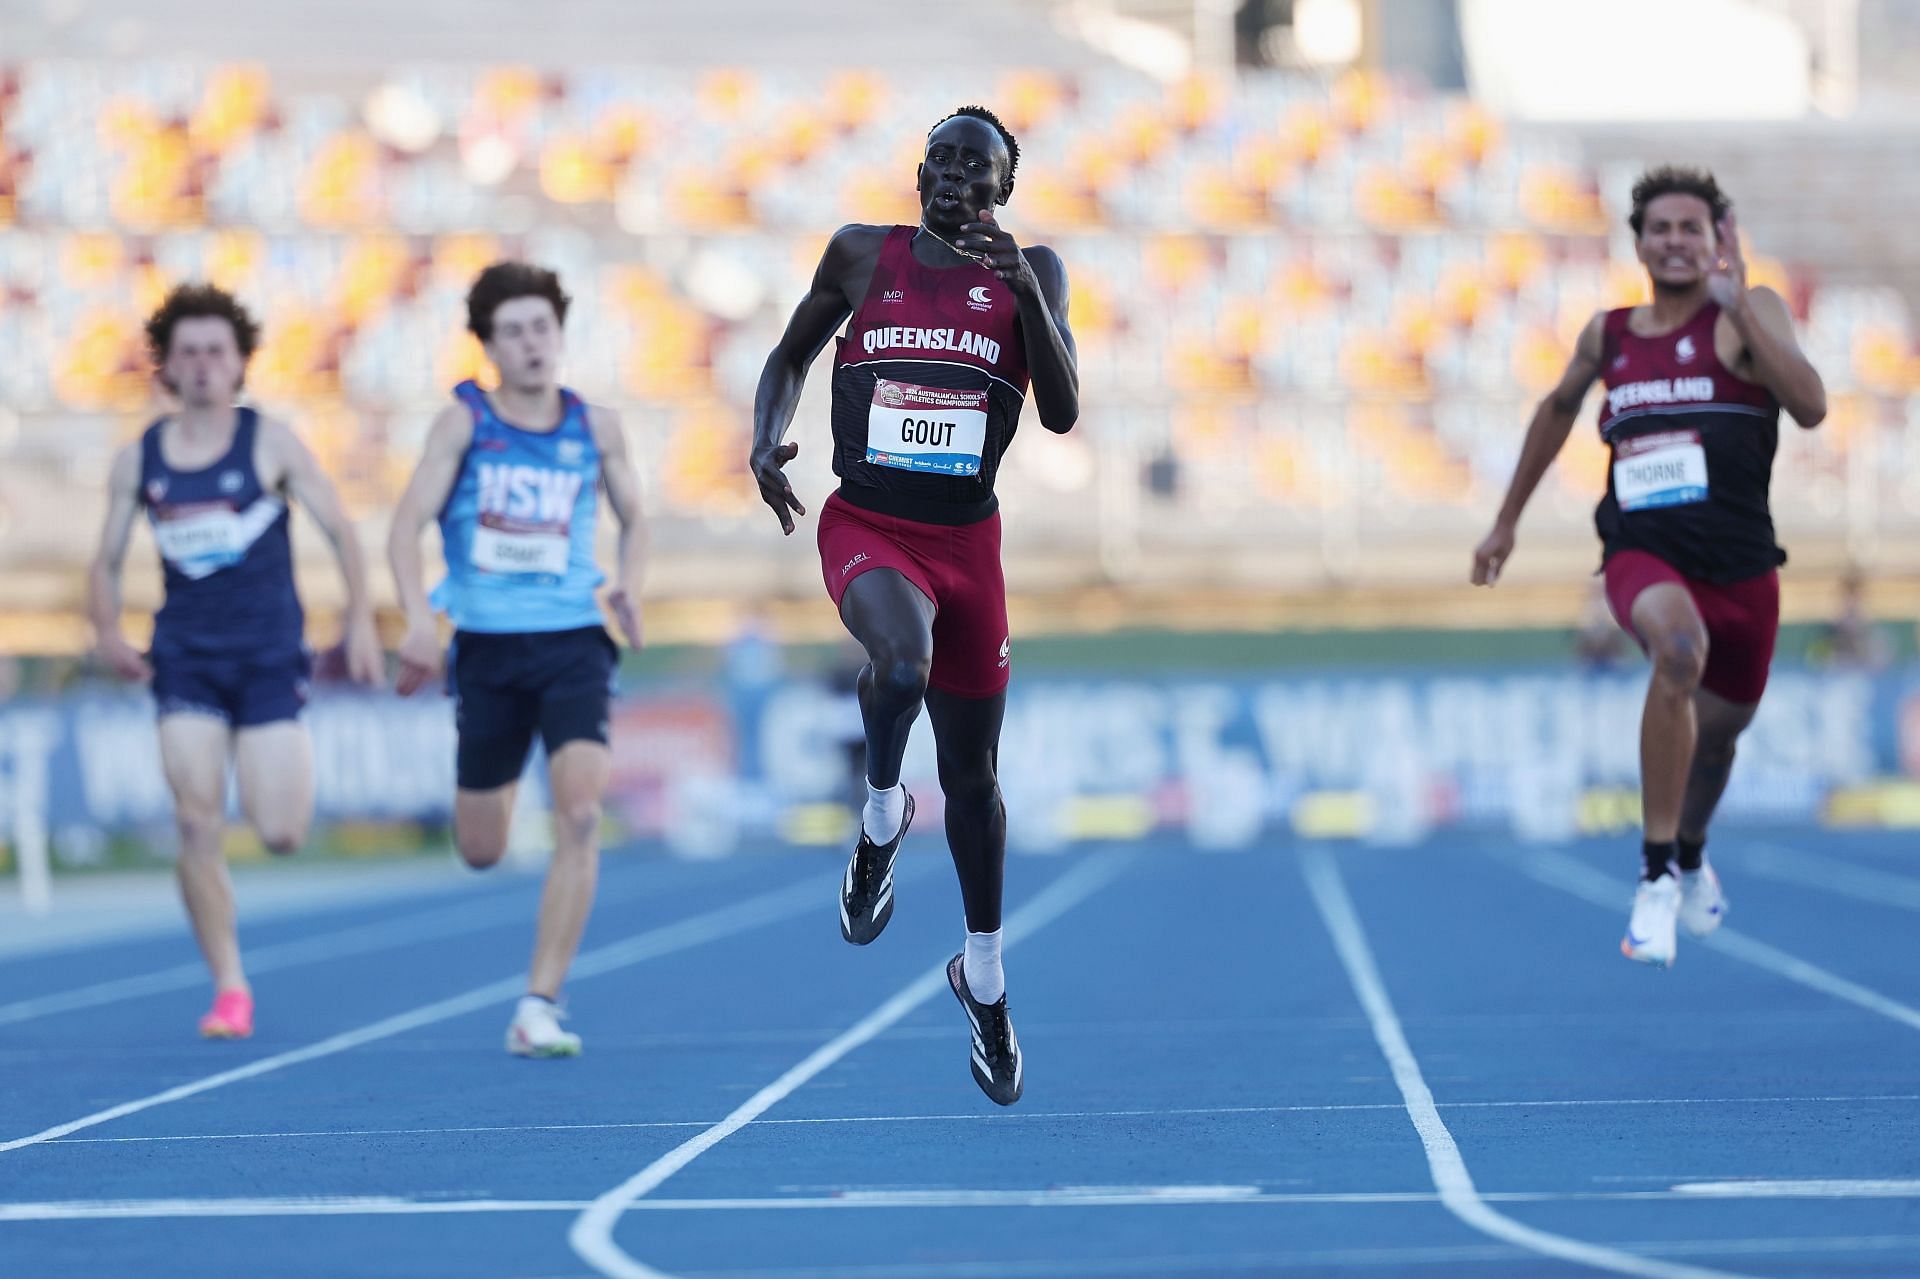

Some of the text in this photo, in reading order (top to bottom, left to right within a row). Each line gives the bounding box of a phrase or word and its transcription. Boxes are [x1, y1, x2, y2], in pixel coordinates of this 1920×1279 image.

[883, 290, 904, 299] IMPI
[863, 326, 1001, 365] QUEENSLAND
[904, 394, 935, 404] ATHLETICS
[935, 398, 980, 407] CHAMPIONSHIPS
[918, 390, 950, 399] AUSTRALIAN
[960, 393, 981, 401] SCHOOLS
[901, 417, 956, 447] GOUT
[1626, 460, 1686, 487] THORNE
[478, 464, 583, 523] NSW
